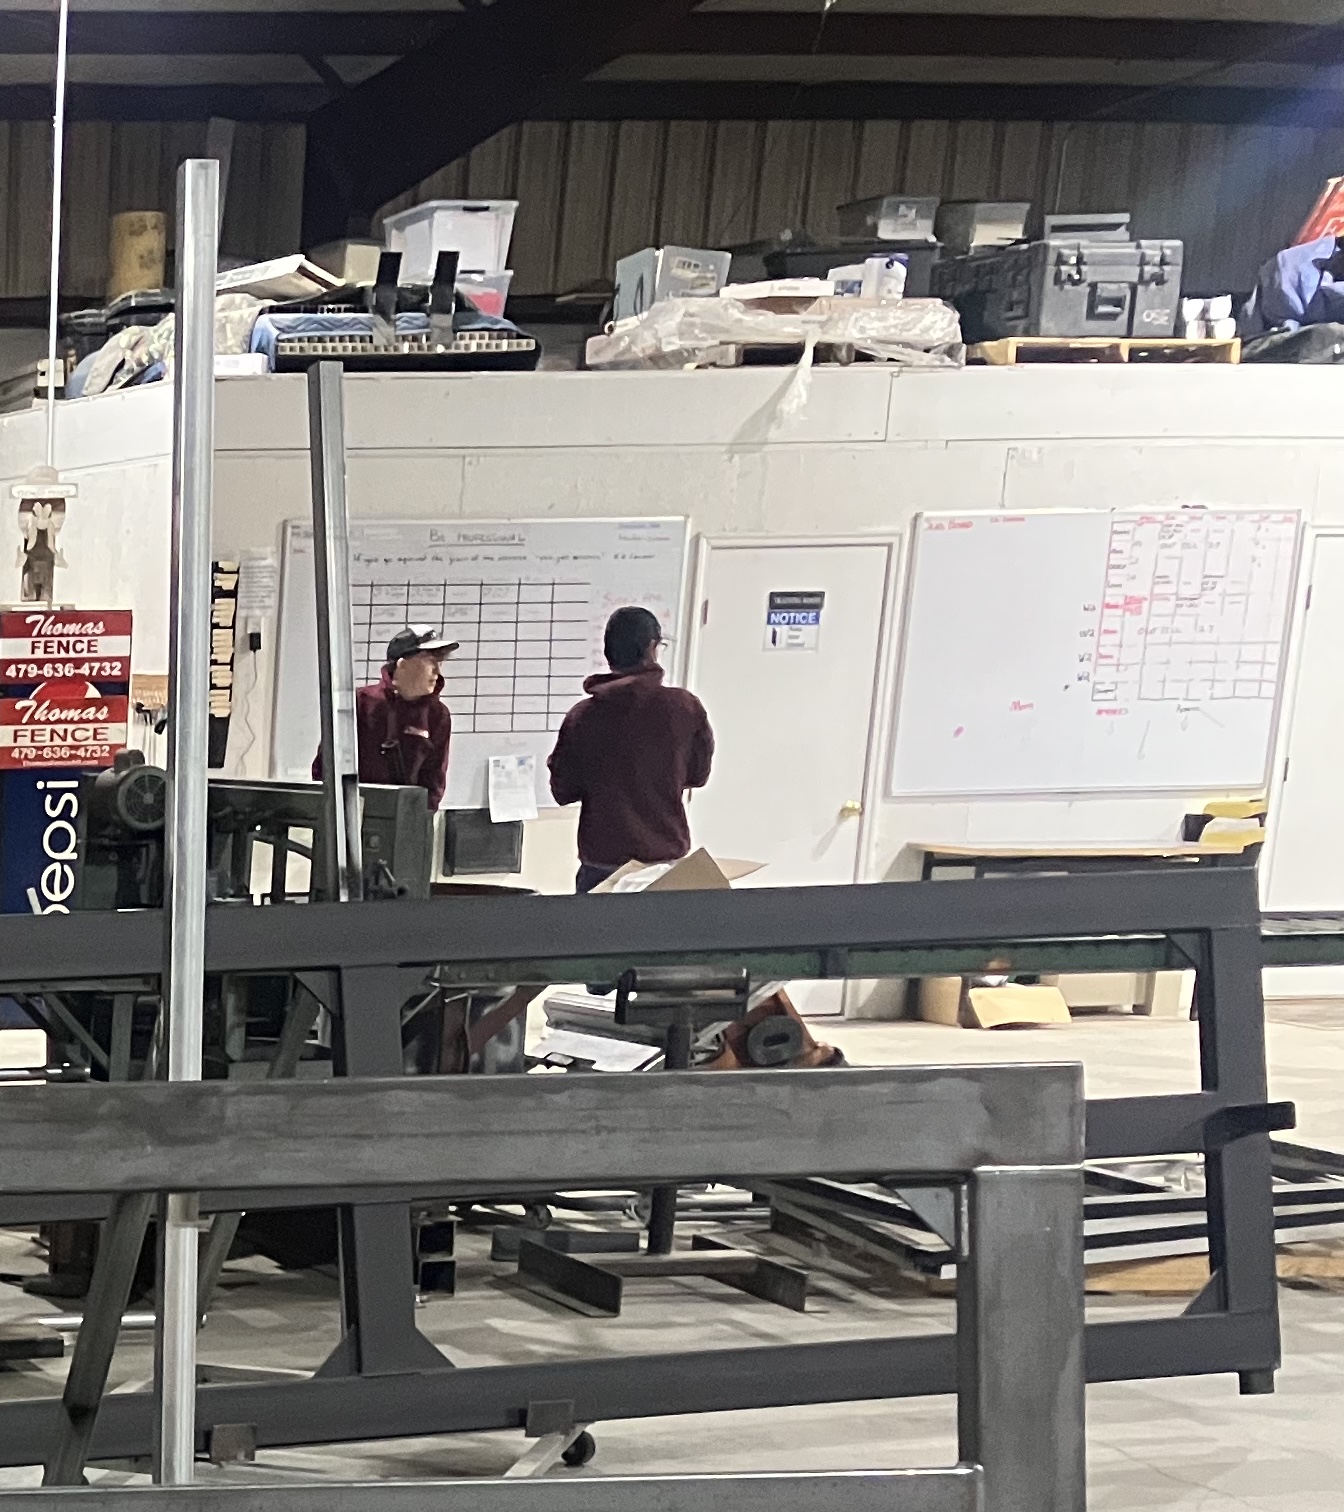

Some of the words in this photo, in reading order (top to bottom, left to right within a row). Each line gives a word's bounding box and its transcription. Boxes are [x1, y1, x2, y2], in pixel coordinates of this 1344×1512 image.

[25, 614, 105, 637] Thomas
[770, 612, 817, 624] NOTICE
[30, 639, 99, 655] FENCE
[5, 662, 122, 678] 479-636-4732
[15, 700, 110, 723] Thomas
[12, 727, 110, 744] FENCE
[10, 745, 111, 759] 479-636-4732
